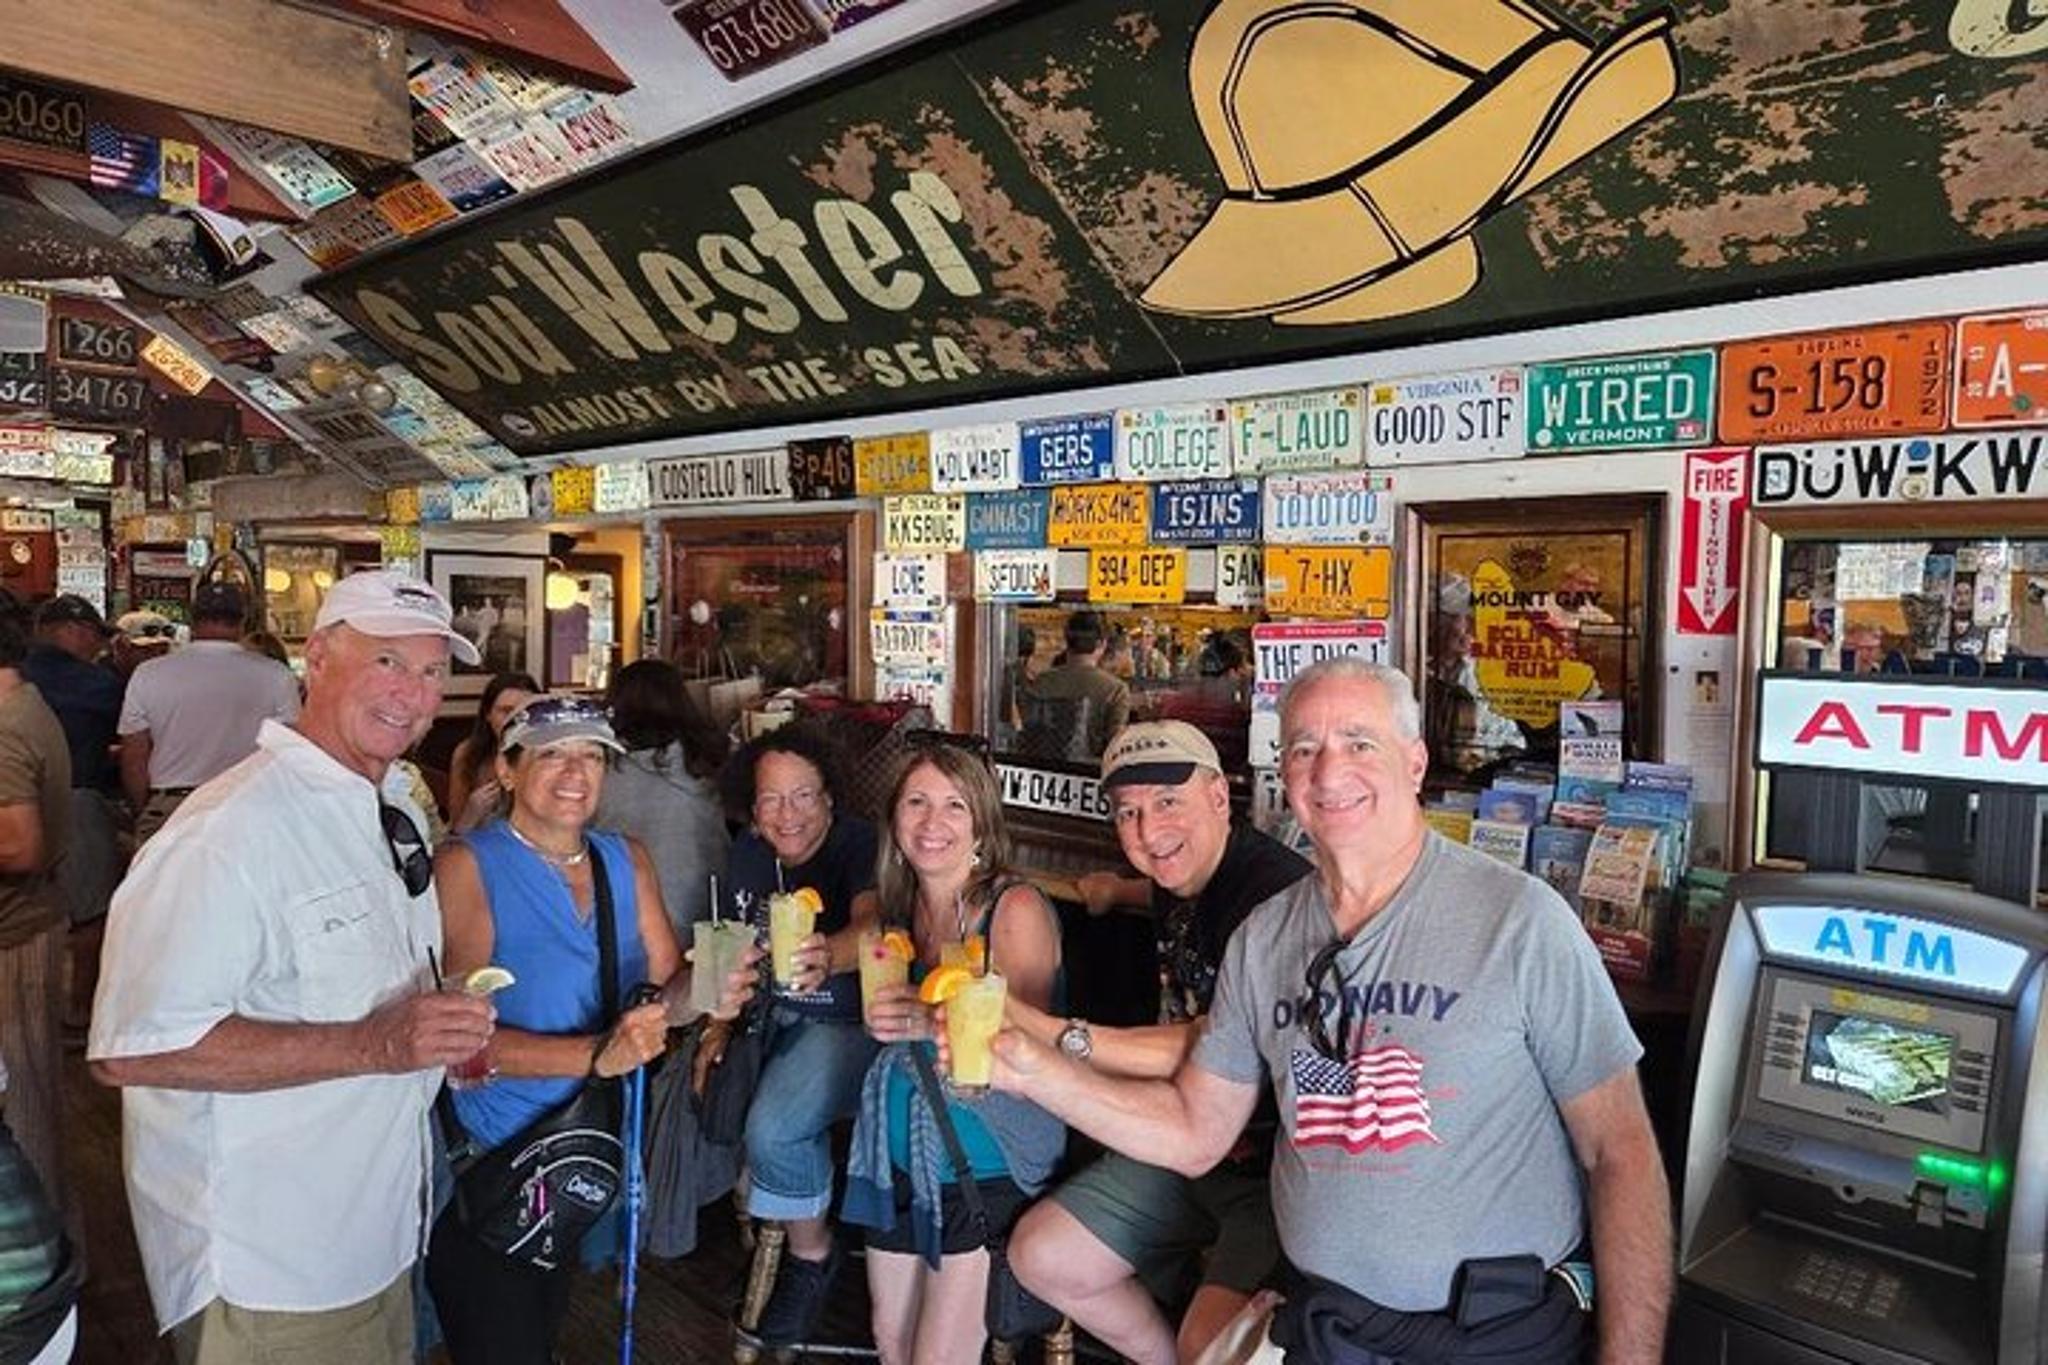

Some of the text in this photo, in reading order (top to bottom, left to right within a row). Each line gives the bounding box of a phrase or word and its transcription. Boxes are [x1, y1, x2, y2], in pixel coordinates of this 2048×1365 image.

[534, 335, 982, 436] ALMOST BY THE SEA
[1406, 379, 1483, 399] VIRGINIA
[1543, 373, 1695, 428] WIRED
[1748, 355, 1886, 418] S-158
[1920, 341, 1939, 416] 1972
[1242, 408, 1350, 457] F-LAUD
[1375, 397, 1516, 447] GOOD STF
[1566, 425, 1666, 444] VERMONT
[1040, 433, 1094, 468] GERS
[1129, 426, 1221, 470] COLEGE
[661, 459, 736, 500] COSTELLO
[742, 455, 782, 496] HILL
[1693, 468, 1739, 494] FIRE
[1168, 492, 1244, 528] ISINS
[1297, 559, 1354, 596] 7-HX
[1470, 591, 1603, 608] MOUNT GAY
[1504, 661, 1560, 679] RUM
[1793, 701, 2048, 764] ATM
[1815, 916, 1957, 976] ATM
[1345, 980, 1462, 1022] NAVY
